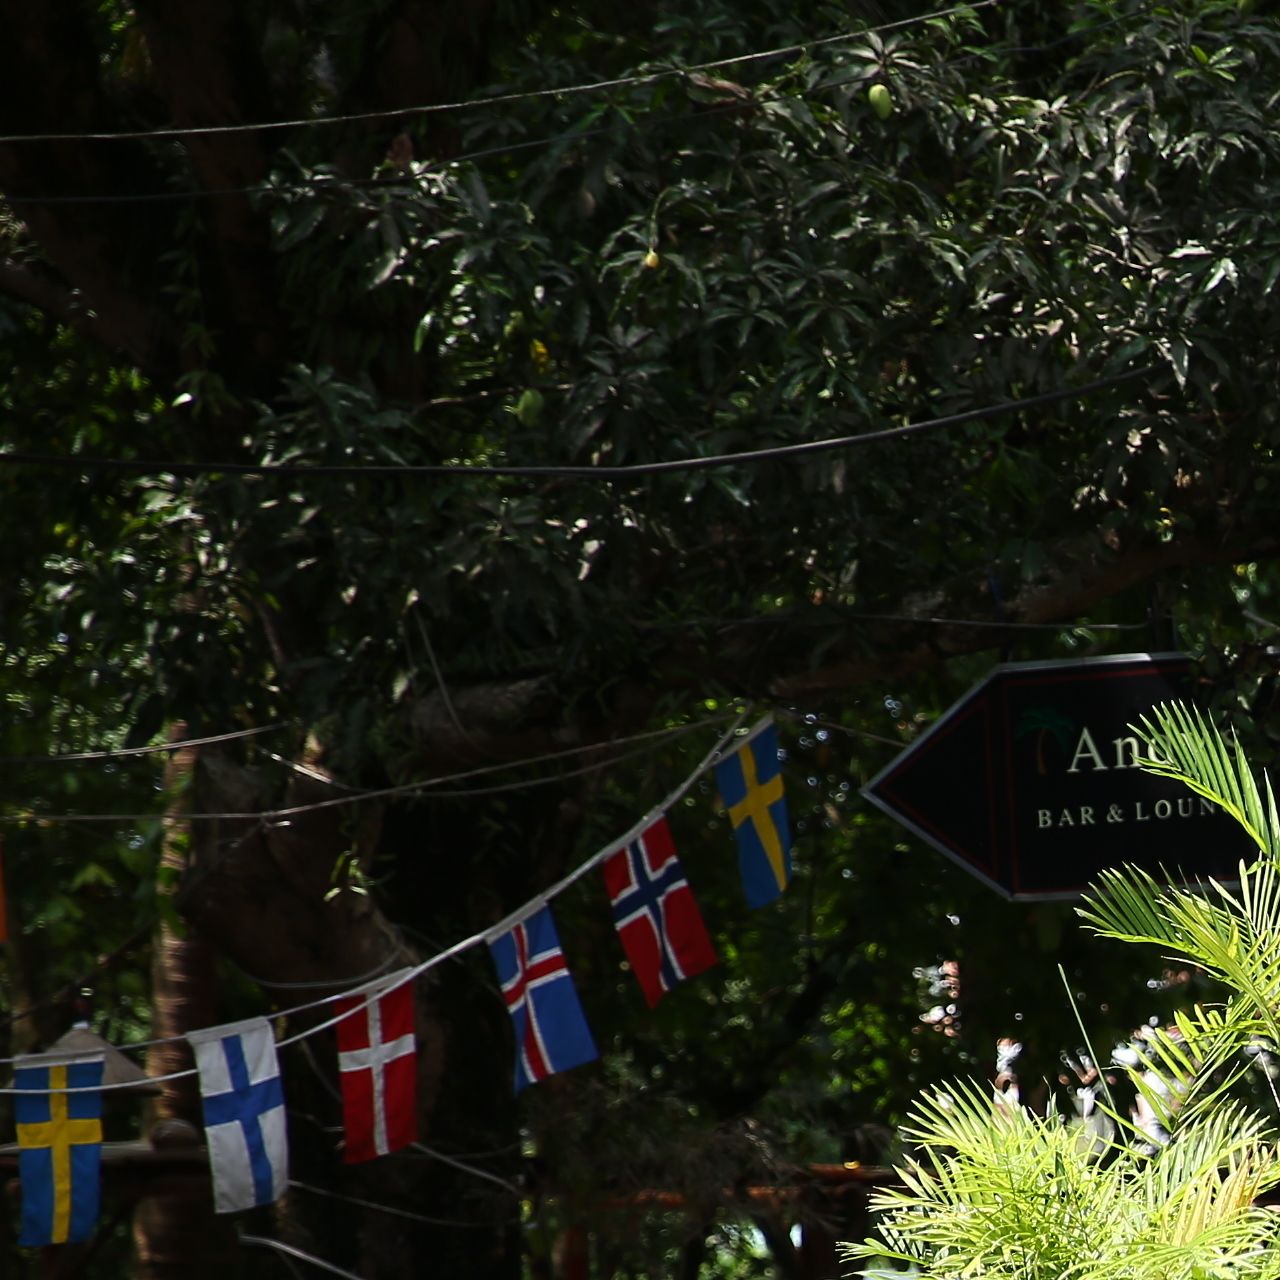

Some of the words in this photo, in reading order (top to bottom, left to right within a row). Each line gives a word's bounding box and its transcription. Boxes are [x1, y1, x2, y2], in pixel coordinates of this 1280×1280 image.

[1038, 804, 1096, 829] BAR
[1105, 803, 1125, 824] &
[1135, 796, 1230, 822] LOUN
